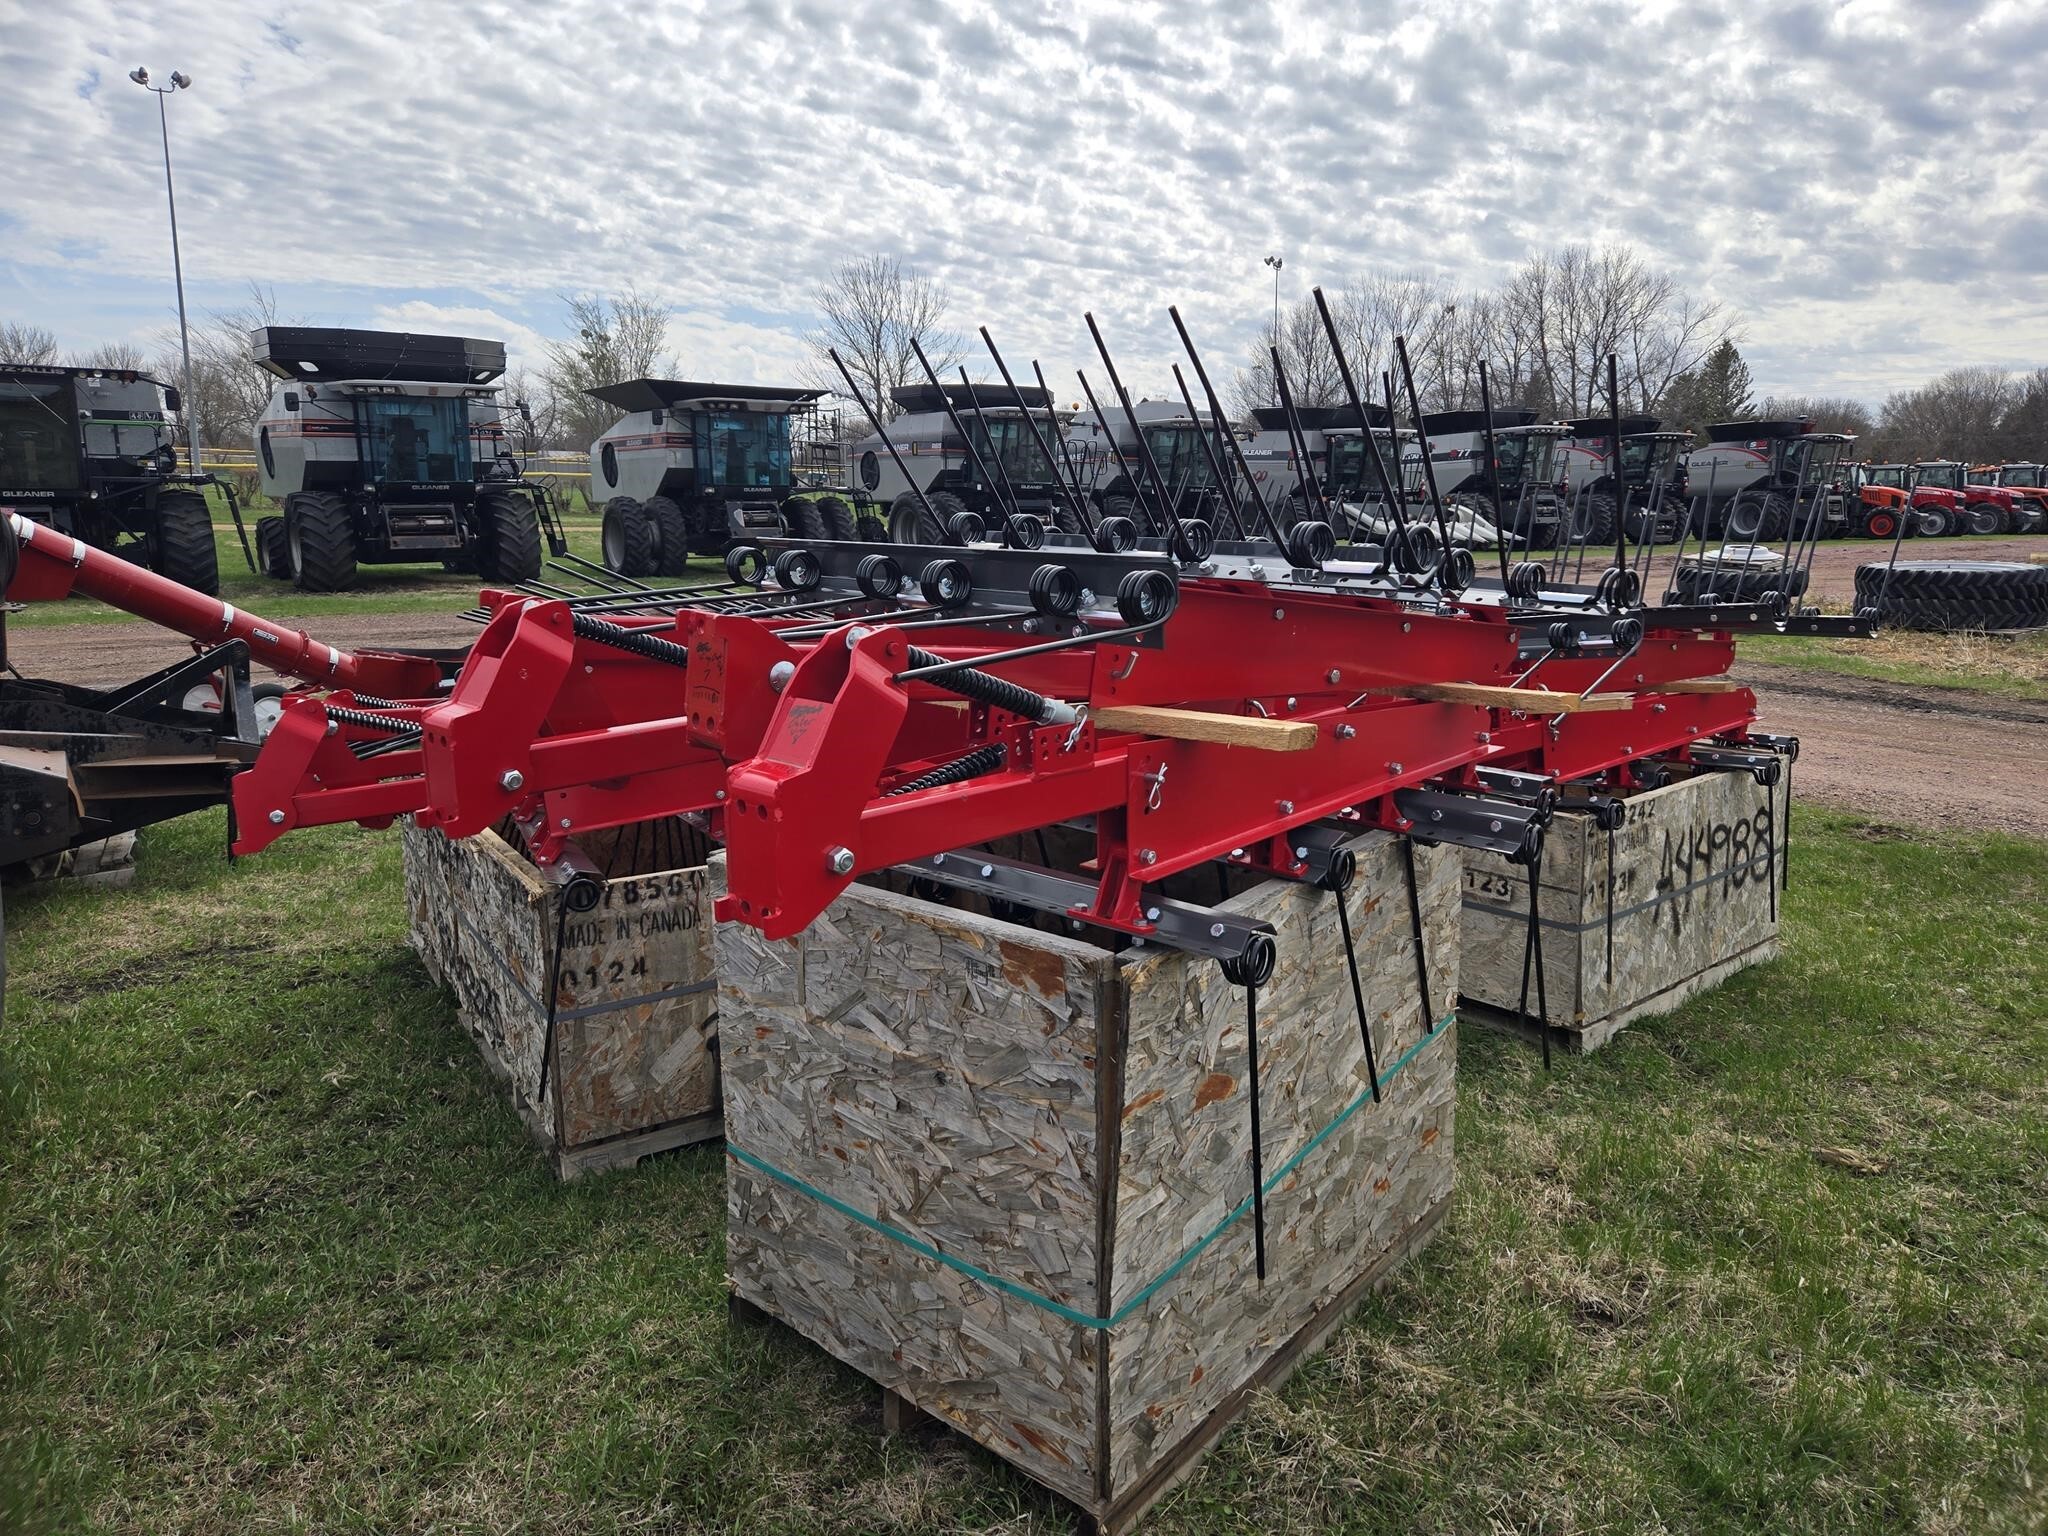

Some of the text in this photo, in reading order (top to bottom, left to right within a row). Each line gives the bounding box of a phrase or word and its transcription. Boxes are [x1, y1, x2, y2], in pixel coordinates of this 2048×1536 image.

[562, 907, 702, 950] MADE IN CANADA
[560, 955, 649, 991] 0124
